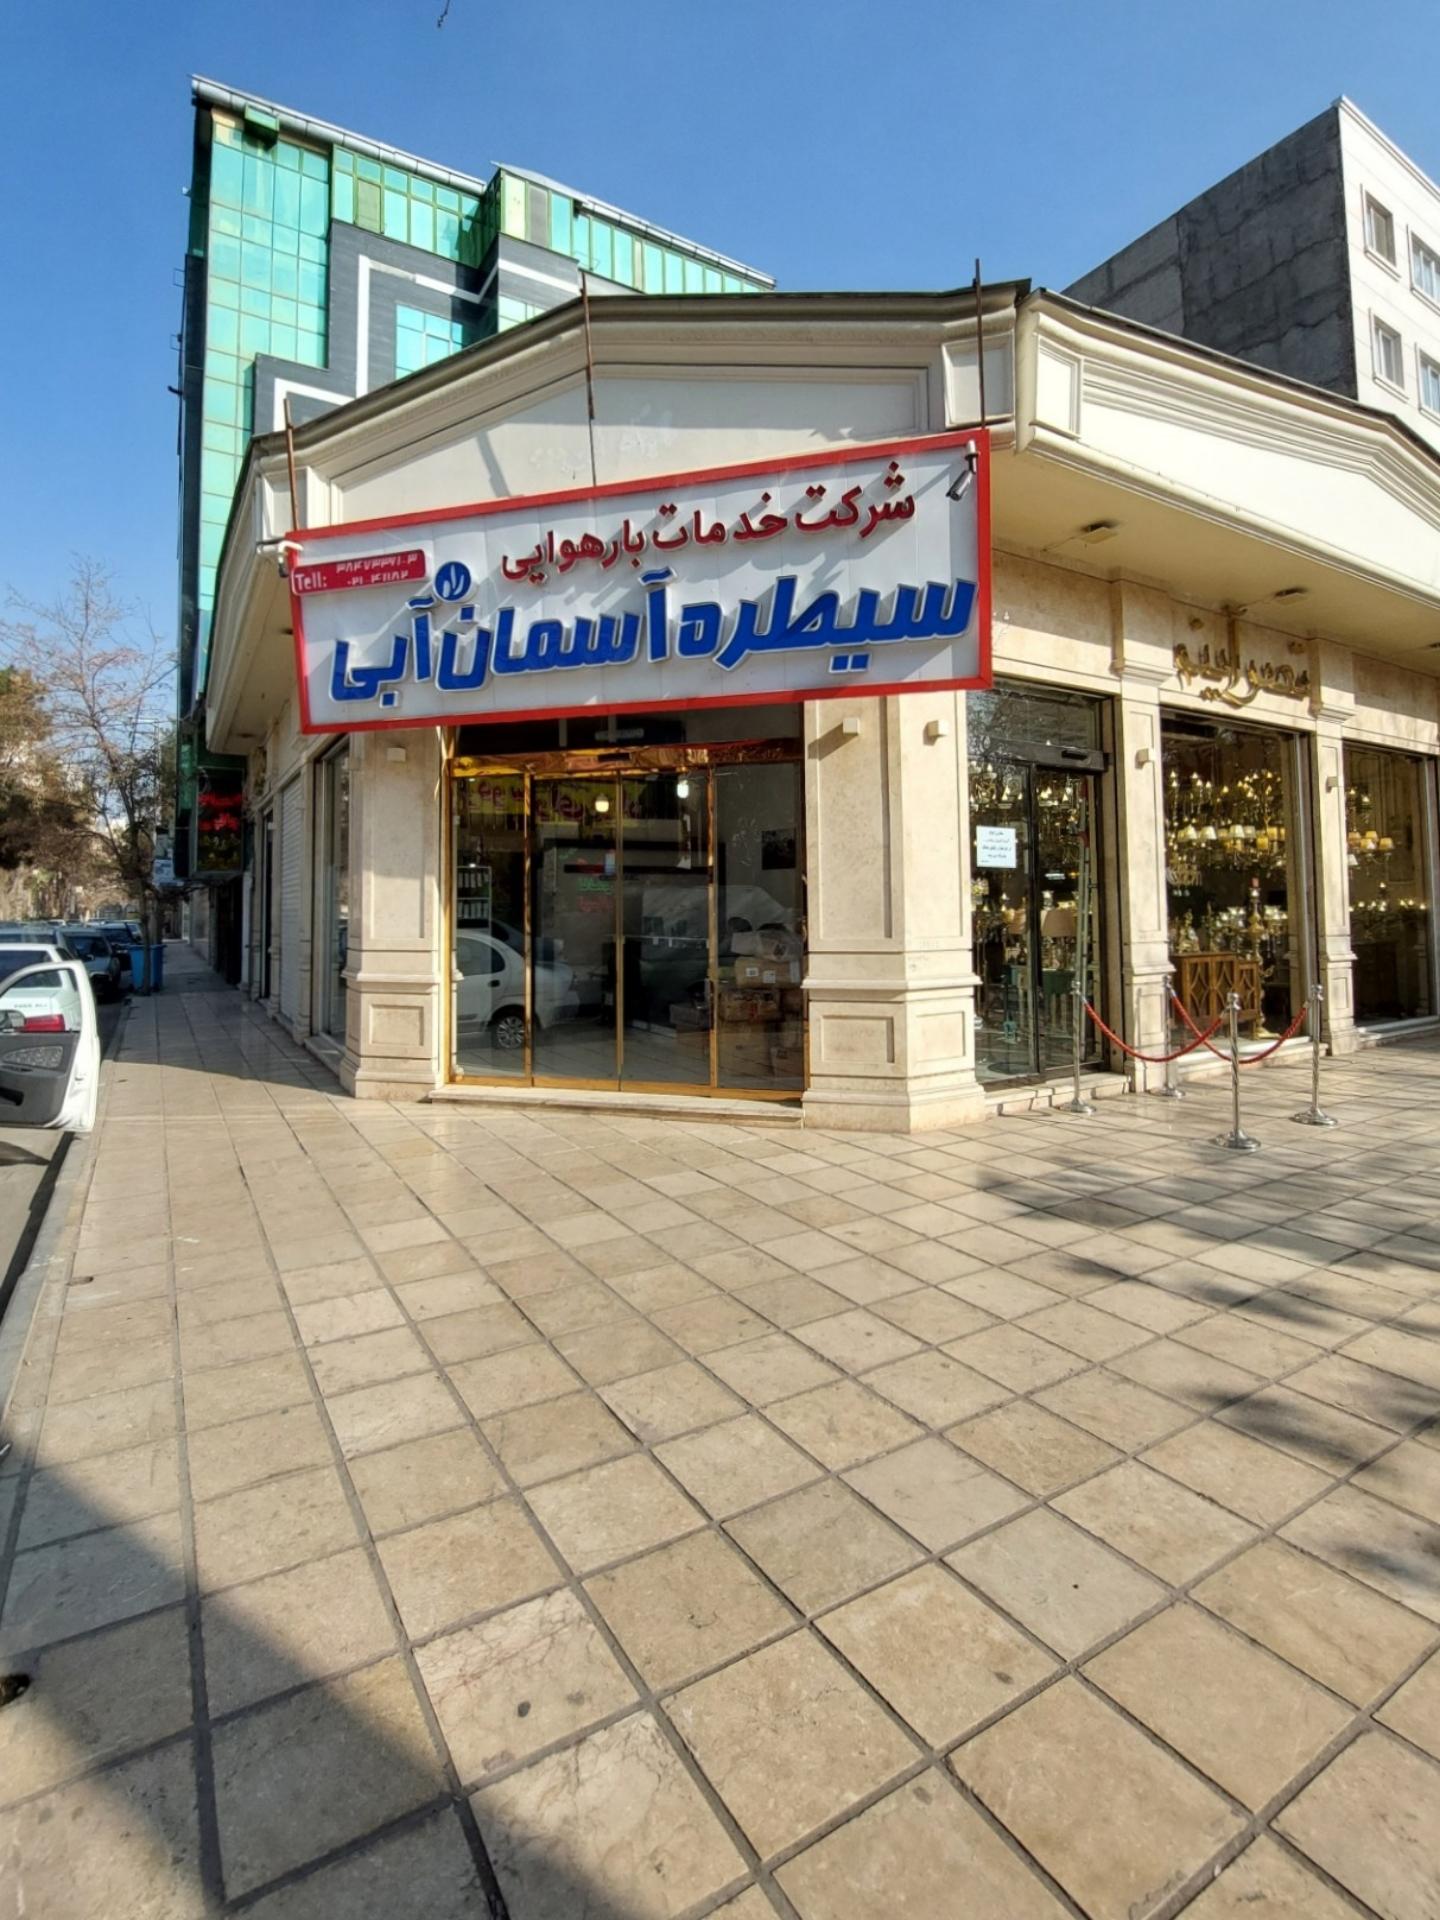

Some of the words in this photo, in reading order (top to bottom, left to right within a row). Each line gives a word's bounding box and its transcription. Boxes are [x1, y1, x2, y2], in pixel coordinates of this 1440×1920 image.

[652, 492, 788, 549] خدمات
[795, 461, 916, 539] شرکت
[295, 571, 328, 591] Tell:
[677, 574, 978, 673] سیطره
[329, 596, 436, 708] آبی
[436, 566, 678, 692] آسمان
